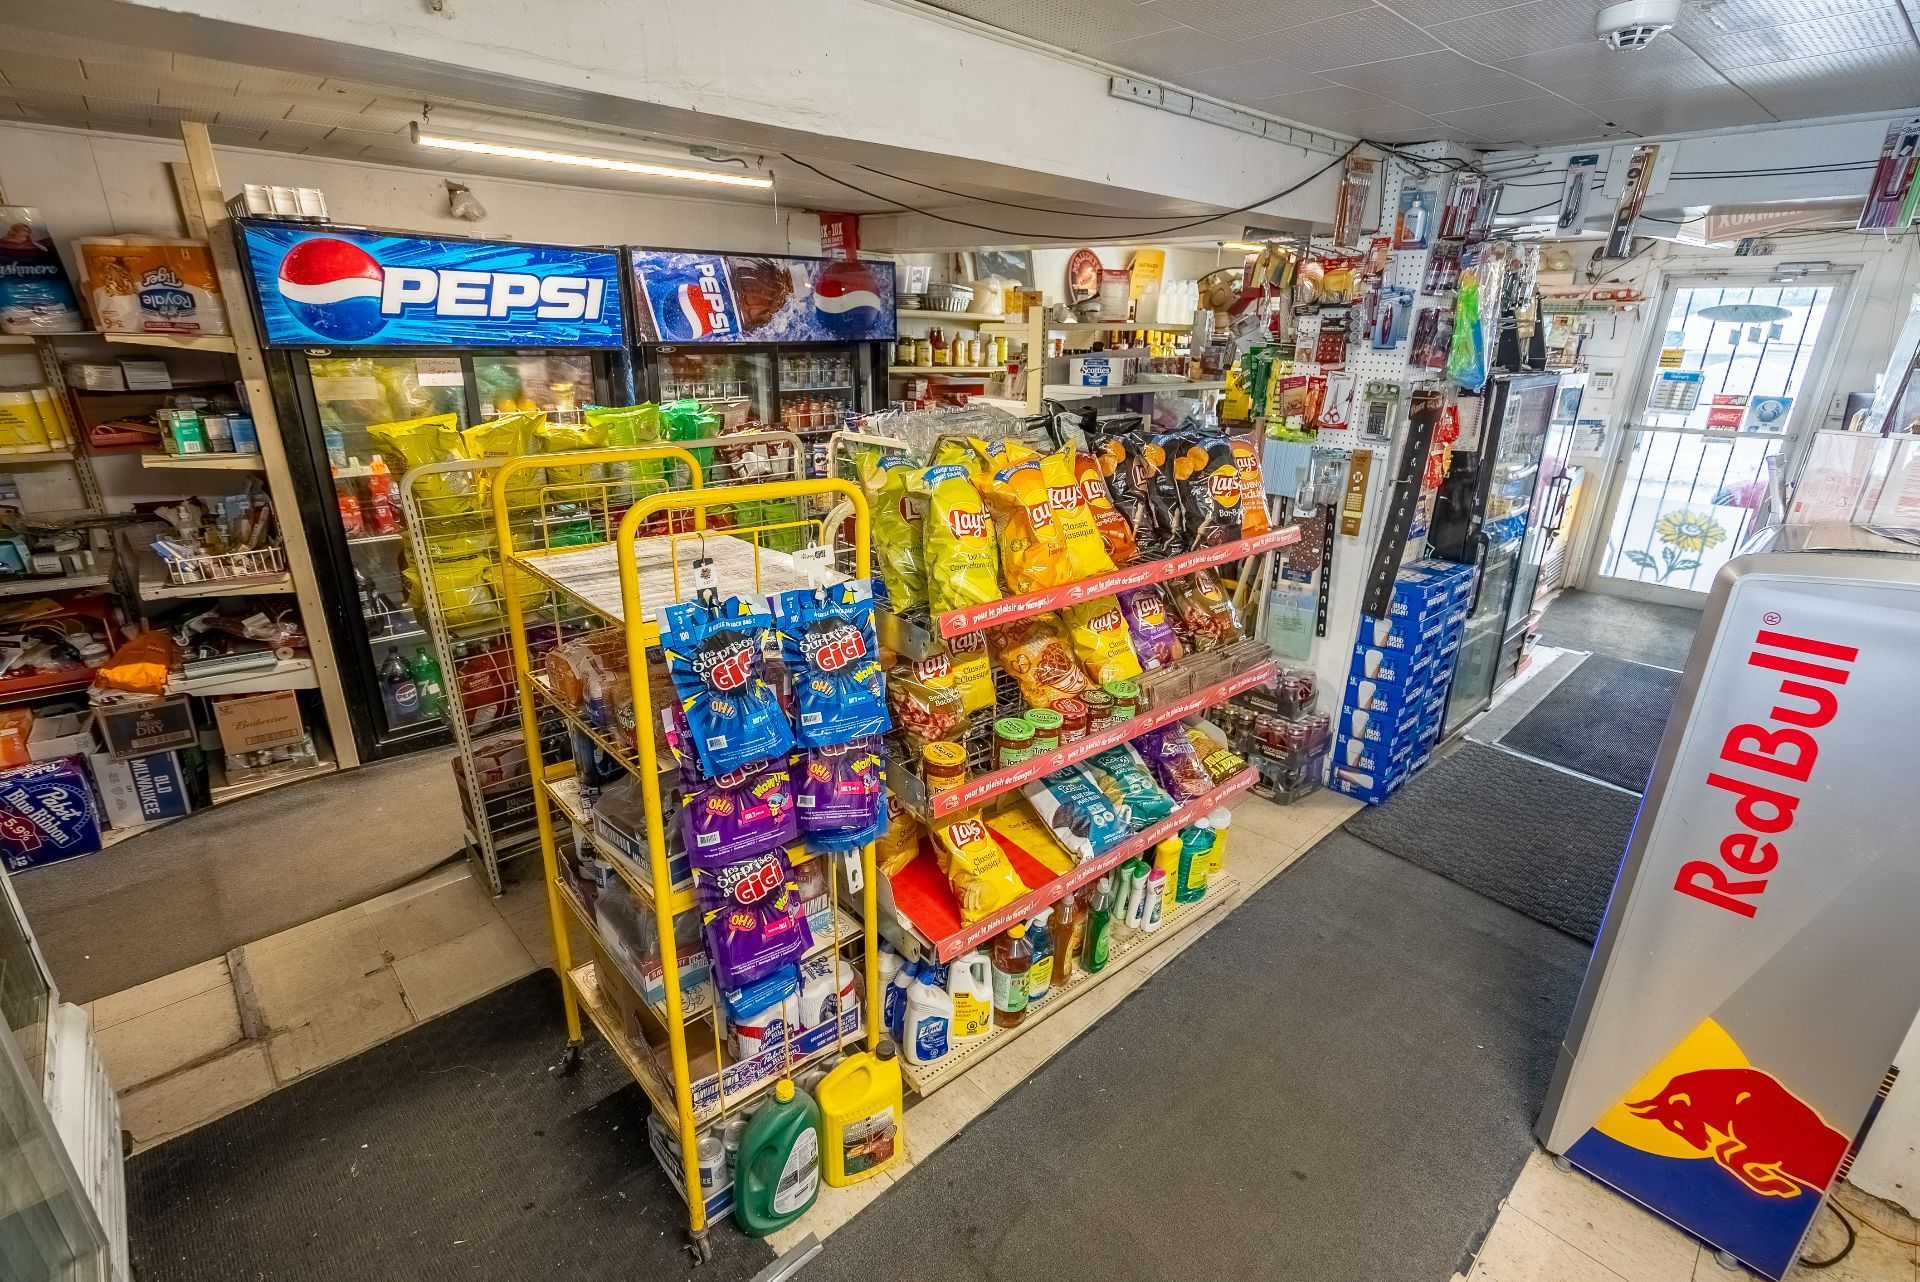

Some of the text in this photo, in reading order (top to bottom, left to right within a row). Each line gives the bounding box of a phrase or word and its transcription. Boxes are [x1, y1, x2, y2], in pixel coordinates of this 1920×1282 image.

[142, 294, 192, 309] Royale
[381, 266, 604, 320] PEPSI
[694, 263, 729, 335] PEPSI
[1080, 364, 1111, 376] Scotties
[1062, 520, 1088, 532] Classic
[1064, 528, 1094, 541] lassique
[1178, 554, 1212, 572] pour le plaisir de
[1086, 582, 1099, 595] pour
[1099, 579, 1105, 590] le
[1105, 575, 1121, 590] plaisir
[1122, 575, 1128, 585] de
[973, 611, 988, 623] pour
[988, 608, 996, 618] le
[996, 604, 1018, 618] plaisir
[1018, 602, 1025, 611] de
[1393, 602, 1408, 610] BUD
[800, 624, 857, 653] Surprises
[1109, 638, 1126, 648] Classi
[1389, 636, 1404, 644] BUD
[692, 637, 754, 673] Surprises
[963, 661, 986, 675] Classic
[1380, 668, 1395, 676] BUD
[1373, 698, 1388, 707] BUD
[232, 714, 289, 732] Budweiser
[1156, 714, 1165, 724] pour
[1165, 710, 1170, 720] le
[1170, 706, 1184, 720] plaisir
[1184, 704, 1189, 712] de
[136, 724, 164, 736] DRY
[1366, 728, 1381, 737] BUD
[1067, 748, 1079, 761] pour
[1079, 746, 1085, 755] le
[1085, 740, 1102, 756] plaisir
[1102, 738, 1109, 746] de
[1360, 757, 1375, 766] BUD
[1672, 628, 1860, 919] Red Bull
[131, 758, 161, 816] MILWAUKEE
[154, 774, 172, 794] OLD
[964, 788, 979, 802] pour
[979, 785, 984, 794] le
[985, 778, 1005, 795] plaisir
[1005, 775, 1012, 784] de
[36, 786, 82, 821] Pabst
[4, 788, 70, 844] Blue Ribbon
[4, 818, 34, 841] 5.9%
[1147, 834, 1157, 844] pour
[1156, 830, 1161, 838] le
[1161, 823, 1174, 837] plaisir
[1174, 820, 1179, 828] de
[973, 850, 997, 867] Classic
[1066, 880, 1076, 890] pour
[1076, 874, 1082, 882] le
[1082, 866, 1095, 879] plaisir
[1095, 864, 1101, 872] de
[967, 932, 980, 944] pour
[980, 926, 987, 936] le
[987, 918, 1005, 932] plaisir
[1005, 914, 1012, 923] de
[921, 1022, 941, 1035] Lysol
